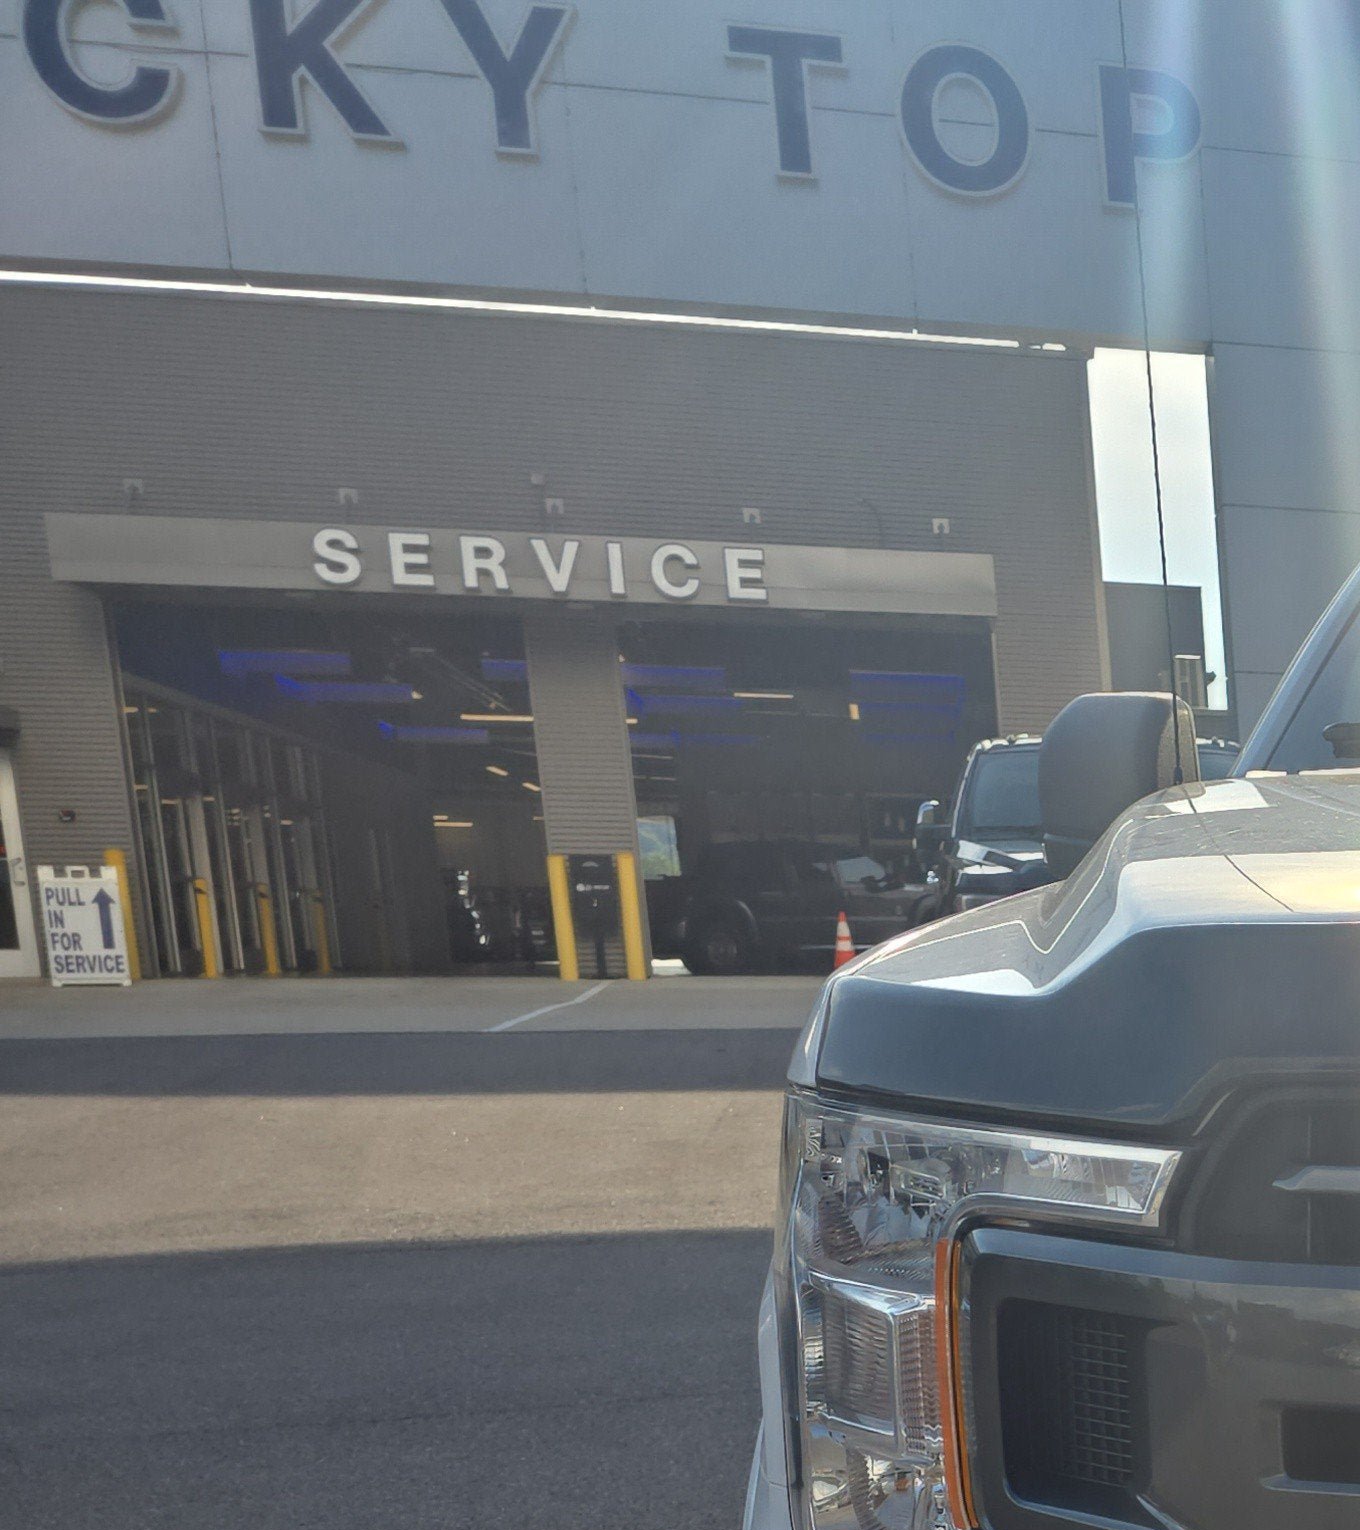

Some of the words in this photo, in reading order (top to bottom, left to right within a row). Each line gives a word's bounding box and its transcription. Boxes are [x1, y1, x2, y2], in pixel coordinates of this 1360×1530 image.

[724, 24, 1202, 208] TOP
[312, 527, 768, 601] SERVICE
[45, 886, 86, 907] PULL
[47, 908, 66, 929] IN
[50, 931, 84, 952] FOR
[53, 953, 126, 975] SERVICE
